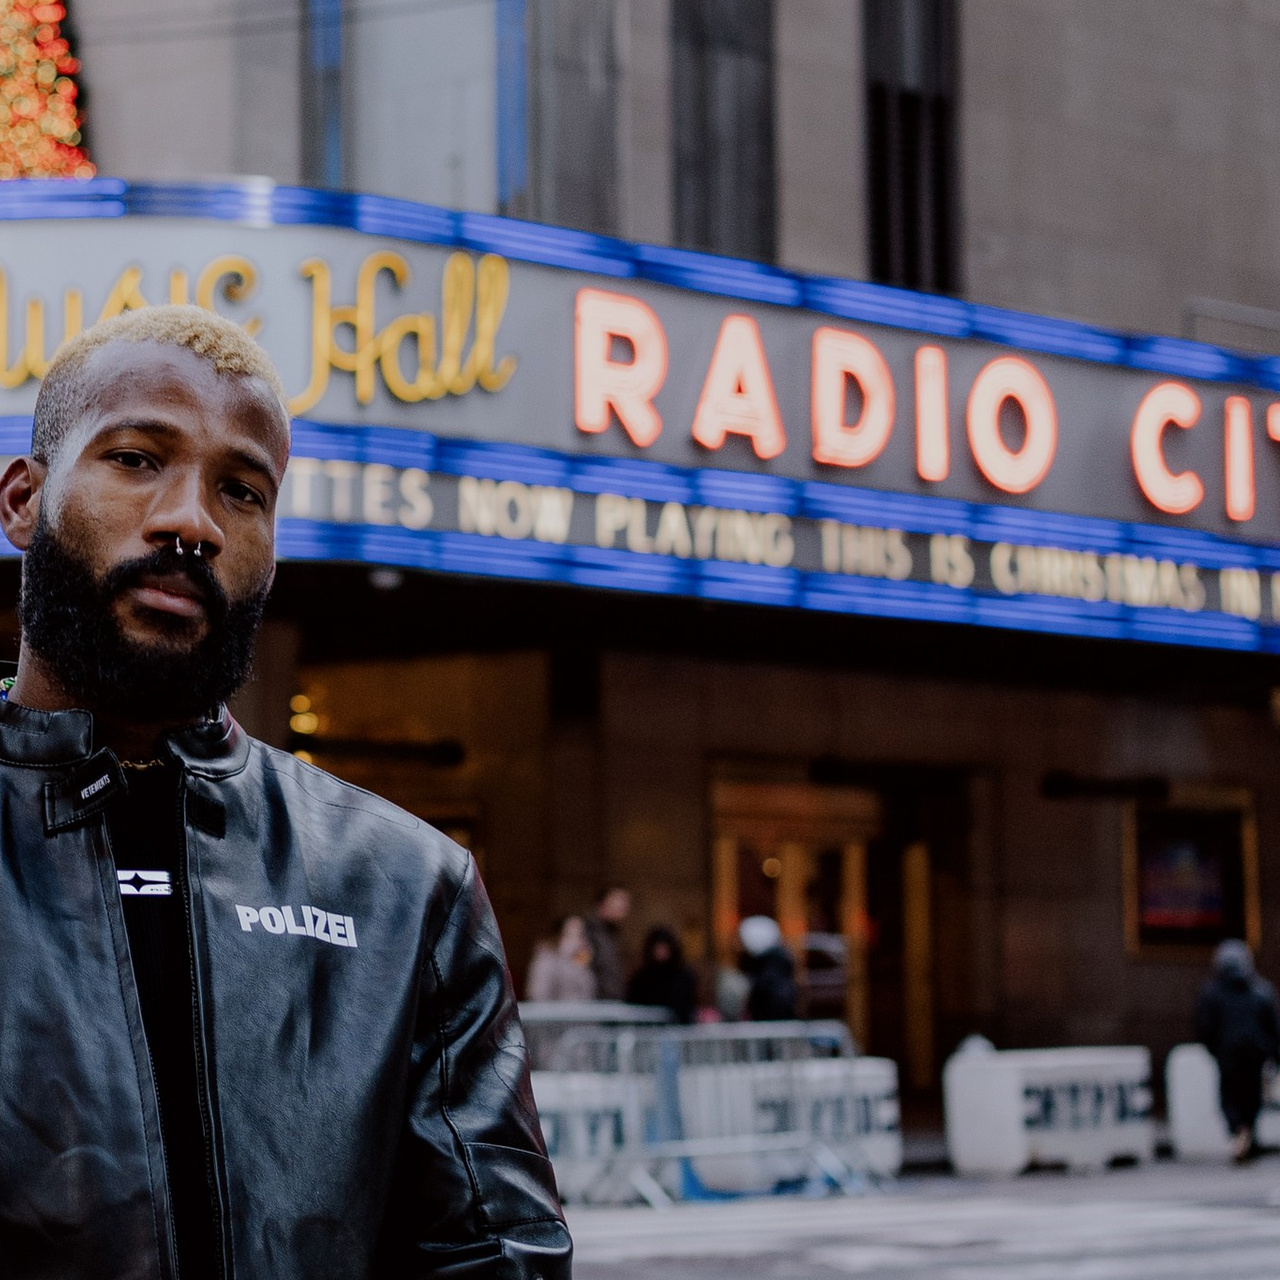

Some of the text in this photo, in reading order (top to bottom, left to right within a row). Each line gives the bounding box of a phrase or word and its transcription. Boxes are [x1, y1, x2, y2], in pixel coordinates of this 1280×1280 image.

[289, 251, 518, 417] Hall
[574, 287, 1058, 495] RADIO
[1130, 380, 1280, 522] CI
[458, 475, 575, 545] NOW
[595, 493, 796, 568] PLAYING
[820, 517, 913, 581] THIS
[929, 532, 975, 589] IS
[990, 540, 1206, 613] CHRISTMAS
[235, 904, 358, 948] POLIZEI
